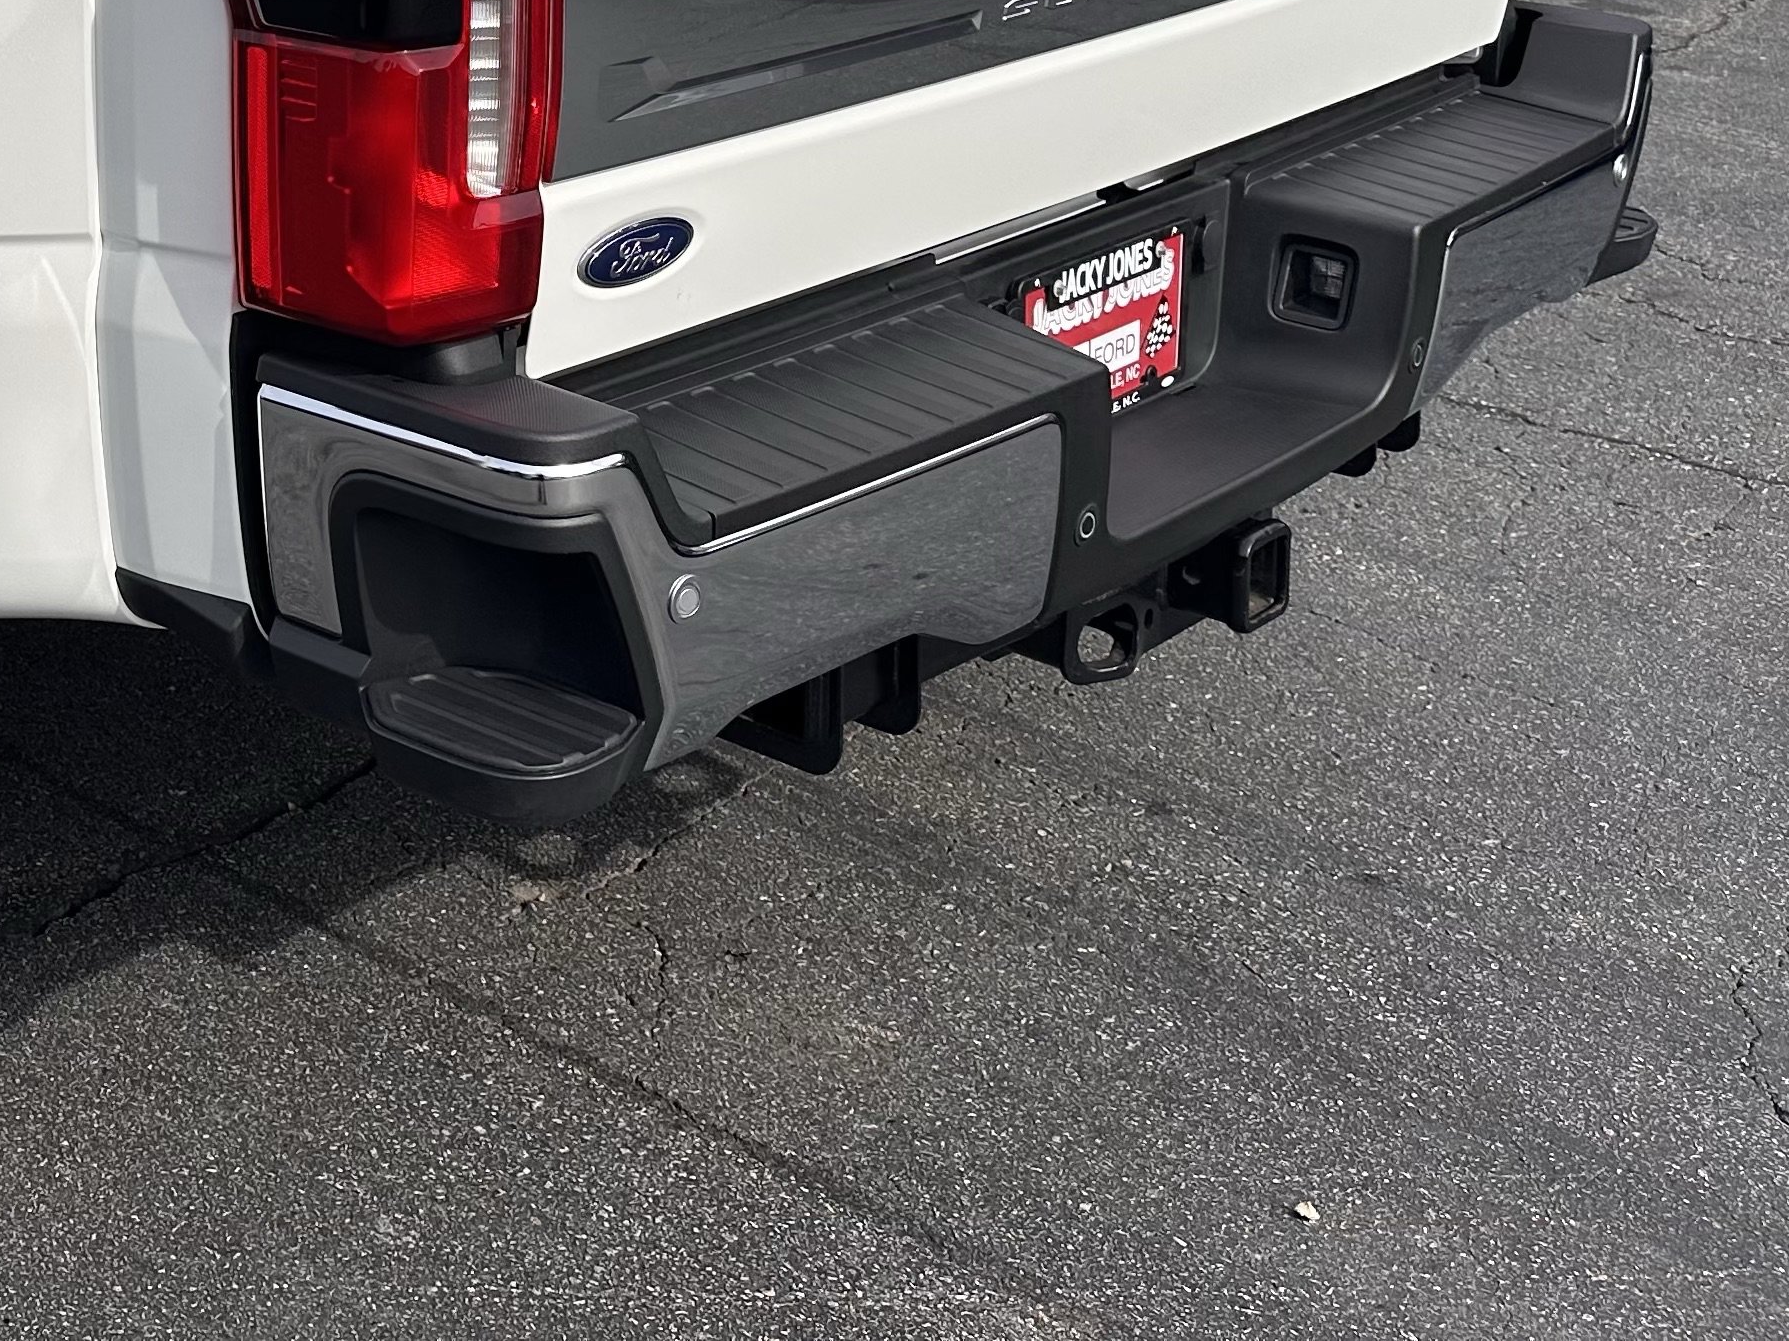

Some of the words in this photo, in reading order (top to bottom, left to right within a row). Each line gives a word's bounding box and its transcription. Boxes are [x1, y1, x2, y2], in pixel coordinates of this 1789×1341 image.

[610, 232, 674, 278] Ford
[1058, 255, 1107, 304] JACKY
[1106, 238, 1153, 285] JONES
[1094, 333, 1136, 364] FORD
[1125, 363, 1141, 383] NC
